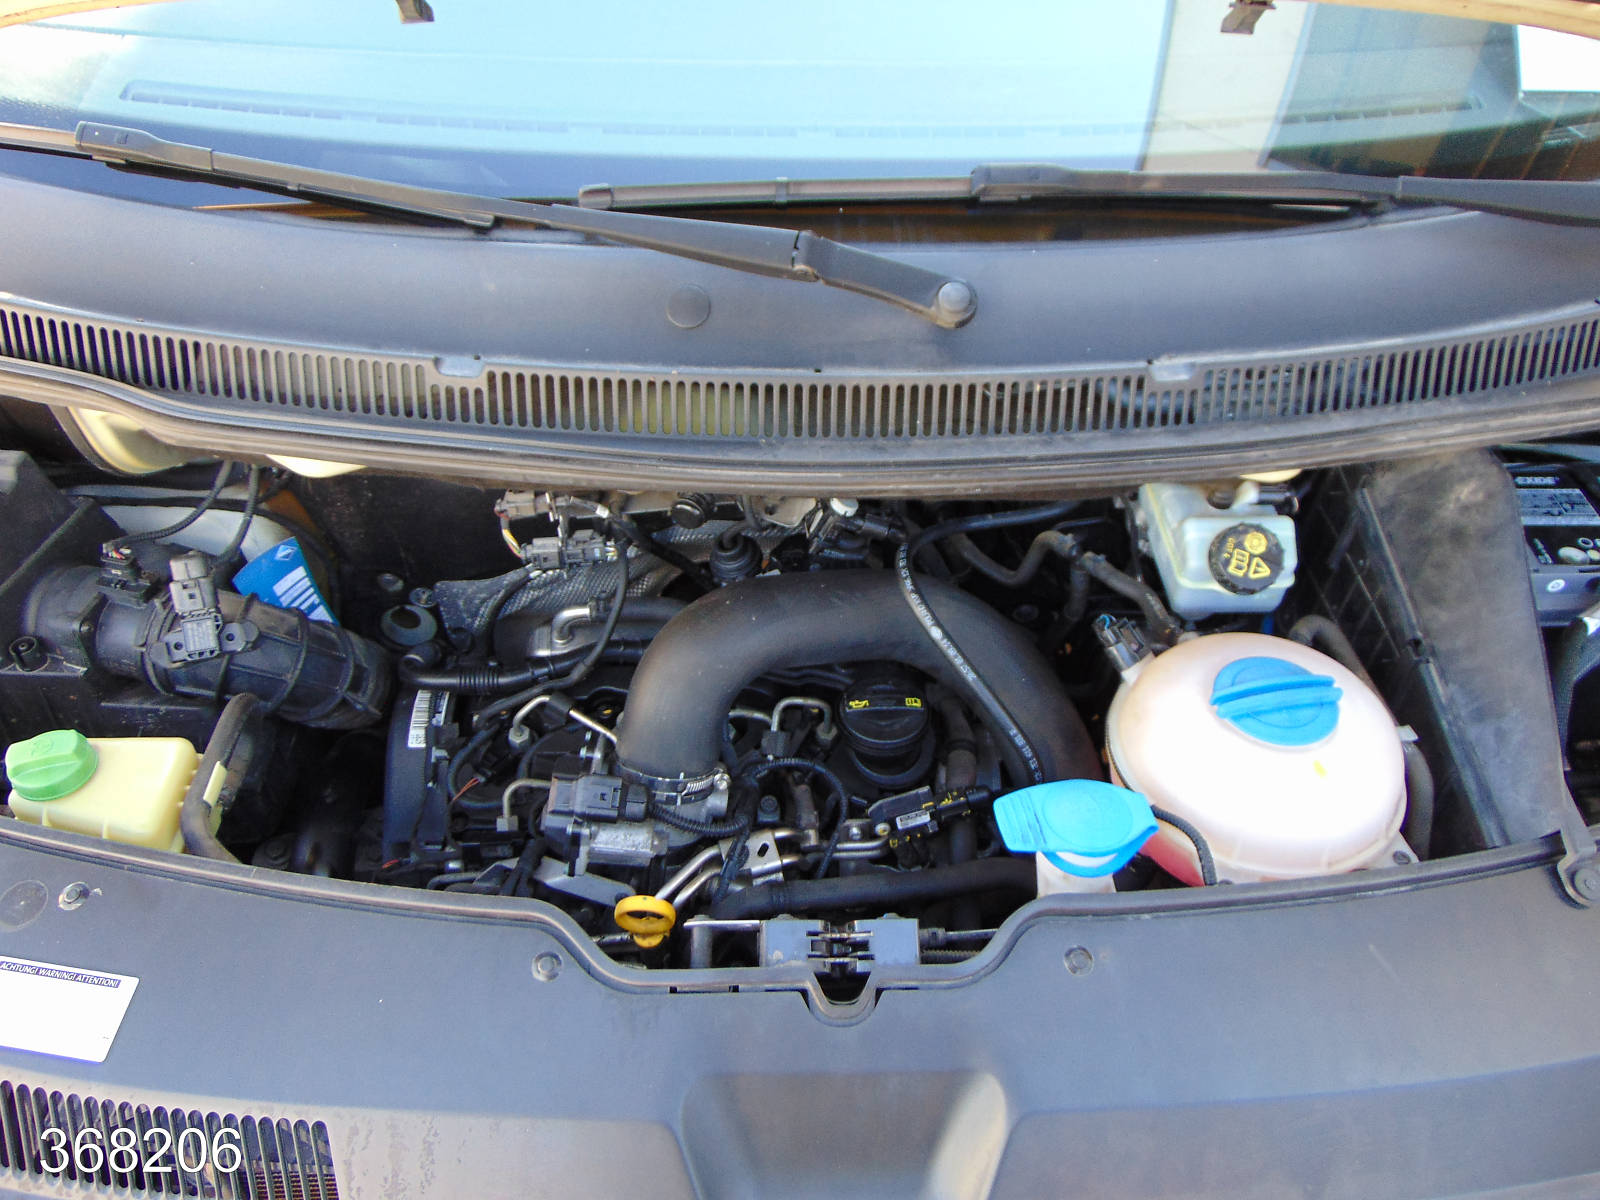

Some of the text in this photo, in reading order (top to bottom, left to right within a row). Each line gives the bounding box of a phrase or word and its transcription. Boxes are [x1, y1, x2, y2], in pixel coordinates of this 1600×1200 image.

[0, 961, 119, 988] ACHTUNG! WARNING! ATTENTION!
